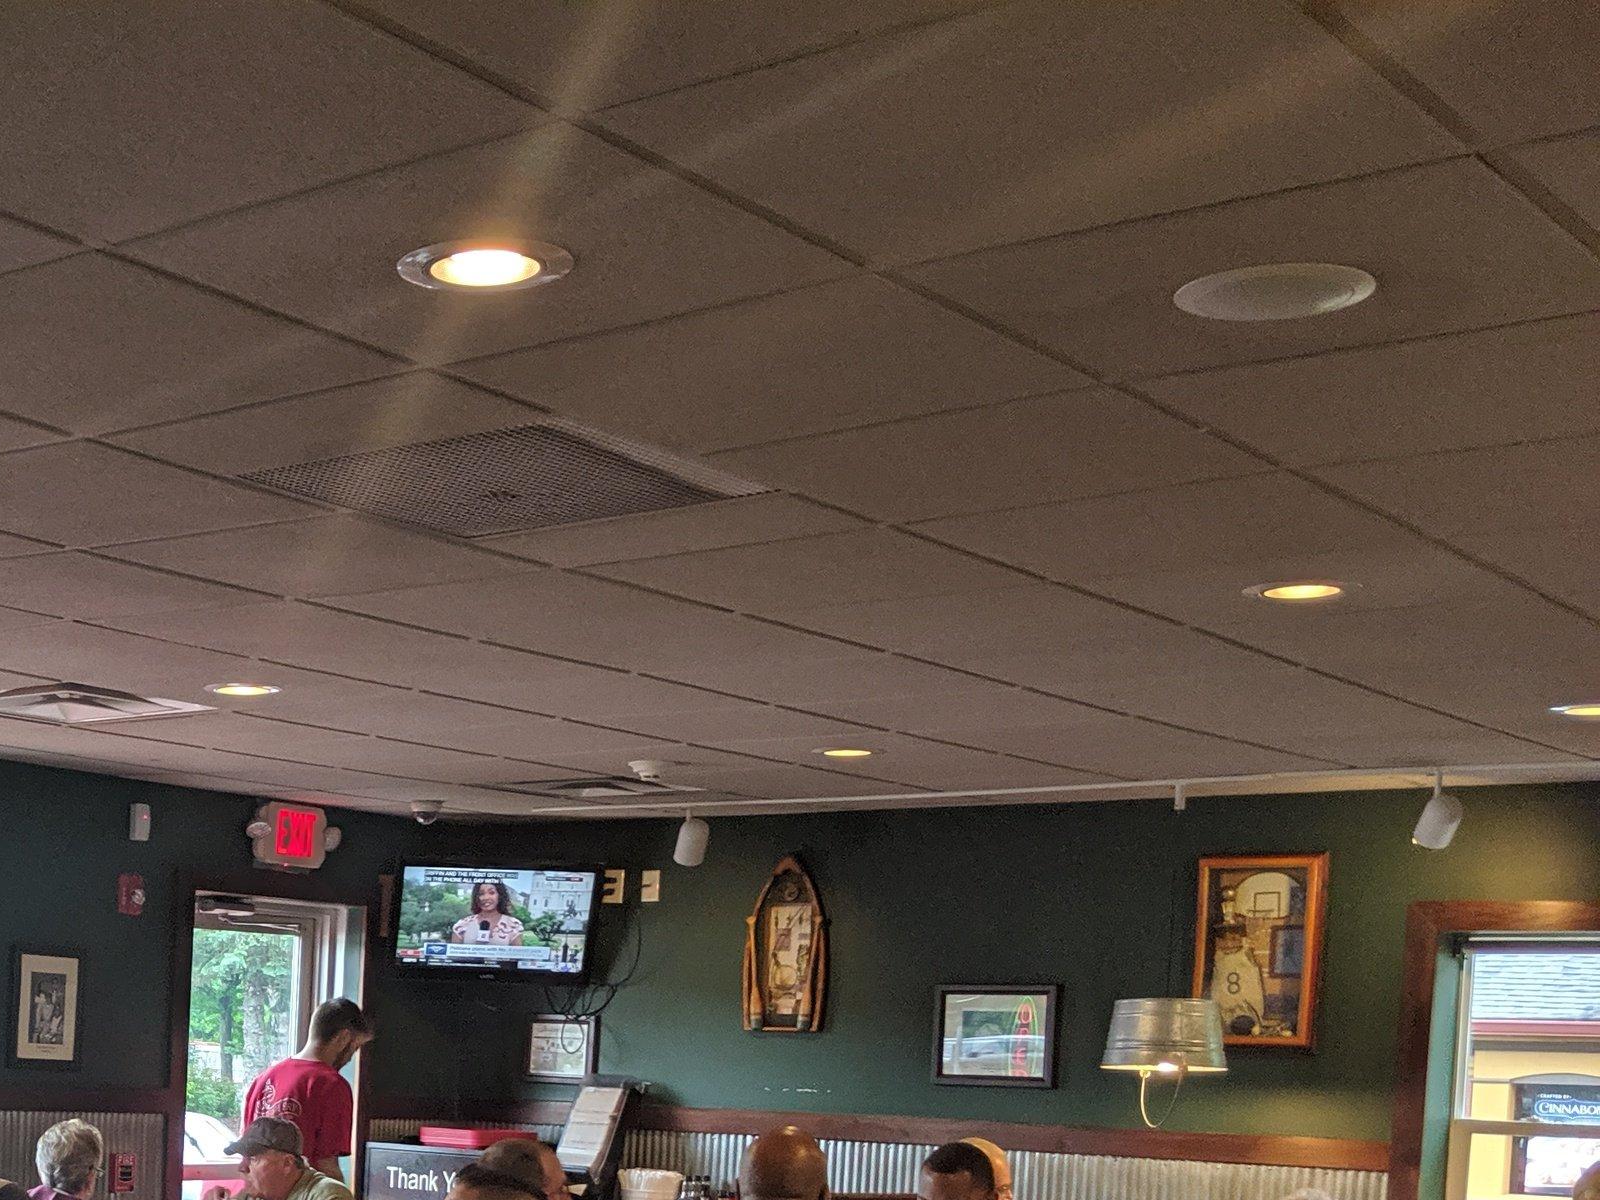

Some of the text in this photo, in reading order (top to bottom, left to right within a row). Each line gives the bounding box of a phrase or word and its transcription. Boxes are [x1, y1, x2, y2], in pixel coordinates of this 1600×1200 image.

[277, 809, 317, 857] EXIT
[1227, 972, 1240, 995] 8
[386, 1166, 457, 1193] Thank Y
